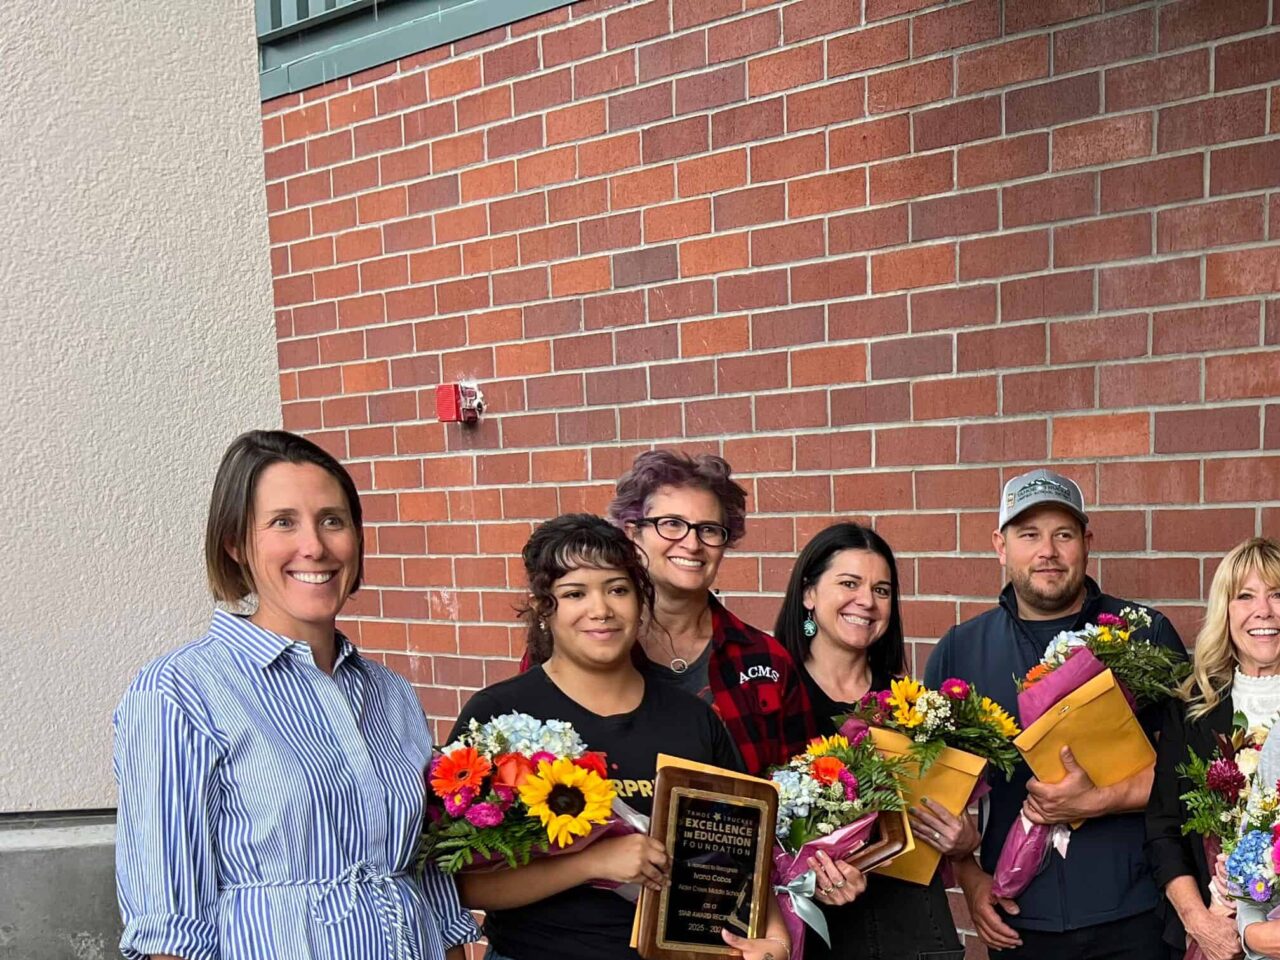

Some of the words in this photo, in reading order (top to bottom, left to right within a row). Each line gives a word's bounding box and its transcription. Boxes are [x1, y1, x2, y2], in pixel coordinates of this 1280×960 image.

[739, 665, 780, 685] ACMS
[611, 779, 655, 797] RPR
[685, 818, 753, 837] EXCELLENCE
[694, 830, 752, 847] EDUCATION
[683, 840, 751, 857] FOUNDATION
[712, 874, 732, 884] Cobos
